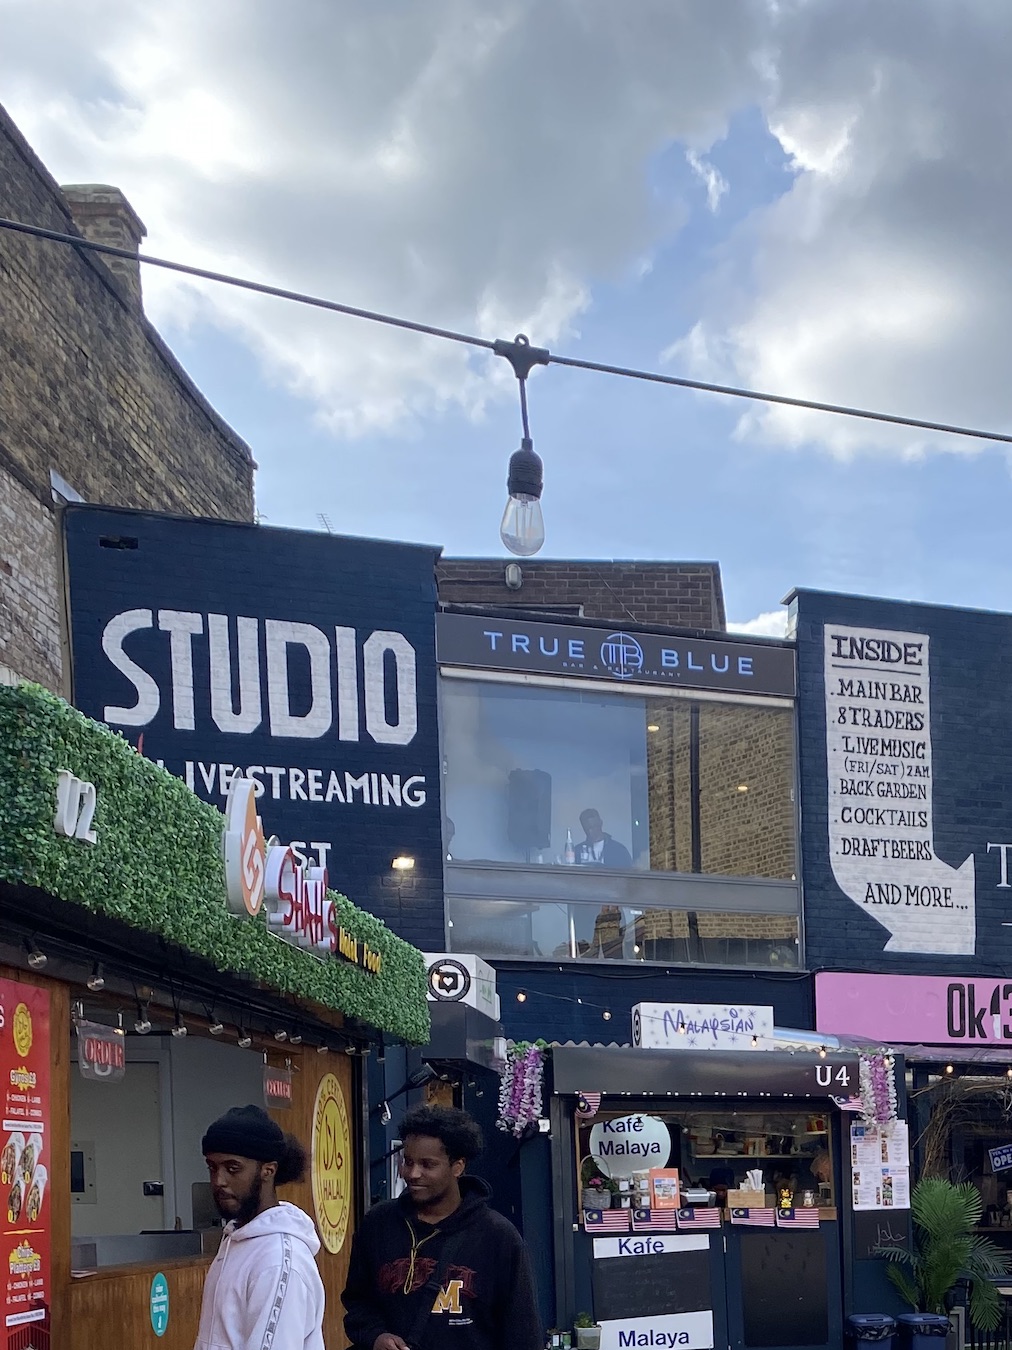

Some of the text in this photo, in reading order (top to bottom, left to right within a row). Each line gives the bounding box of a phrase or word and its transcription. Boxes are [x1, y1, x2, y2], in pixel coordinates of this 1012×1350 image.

[484, 631, 585, 659] TRUE
[661, 649, 754, 675] BLUE
[831, 635, 923, 666] INSIDE
[102, 608, 417, 745] STUDIO
[607, 666, 680, 677] RESTAURANT
[837, 678, 924, 704] MAIN BAR
[837, 706, 924, 731] 8 TRADERS
[842, 736, 926, 760] LIVE MUSIC
[840, 779, 927, 800] BACK GARDEN
[841, 807, 928, 827] COCKTAILS
[841, 837, 932, 860] DRAFT BEERS
[863, 883, 902, 905] AND
[815, 1065, 850, 1087] U4
[603, 1117, 643, 1133] Kafe
[599, 1140, 661, 1157] Malaya
[323, 1178, 344, 1200] HALAL
[618, 1237, 664, 1254] Kafe
[431, 1280, 463, 1313] M
[618, 1330, 690, 1349] Malaya
